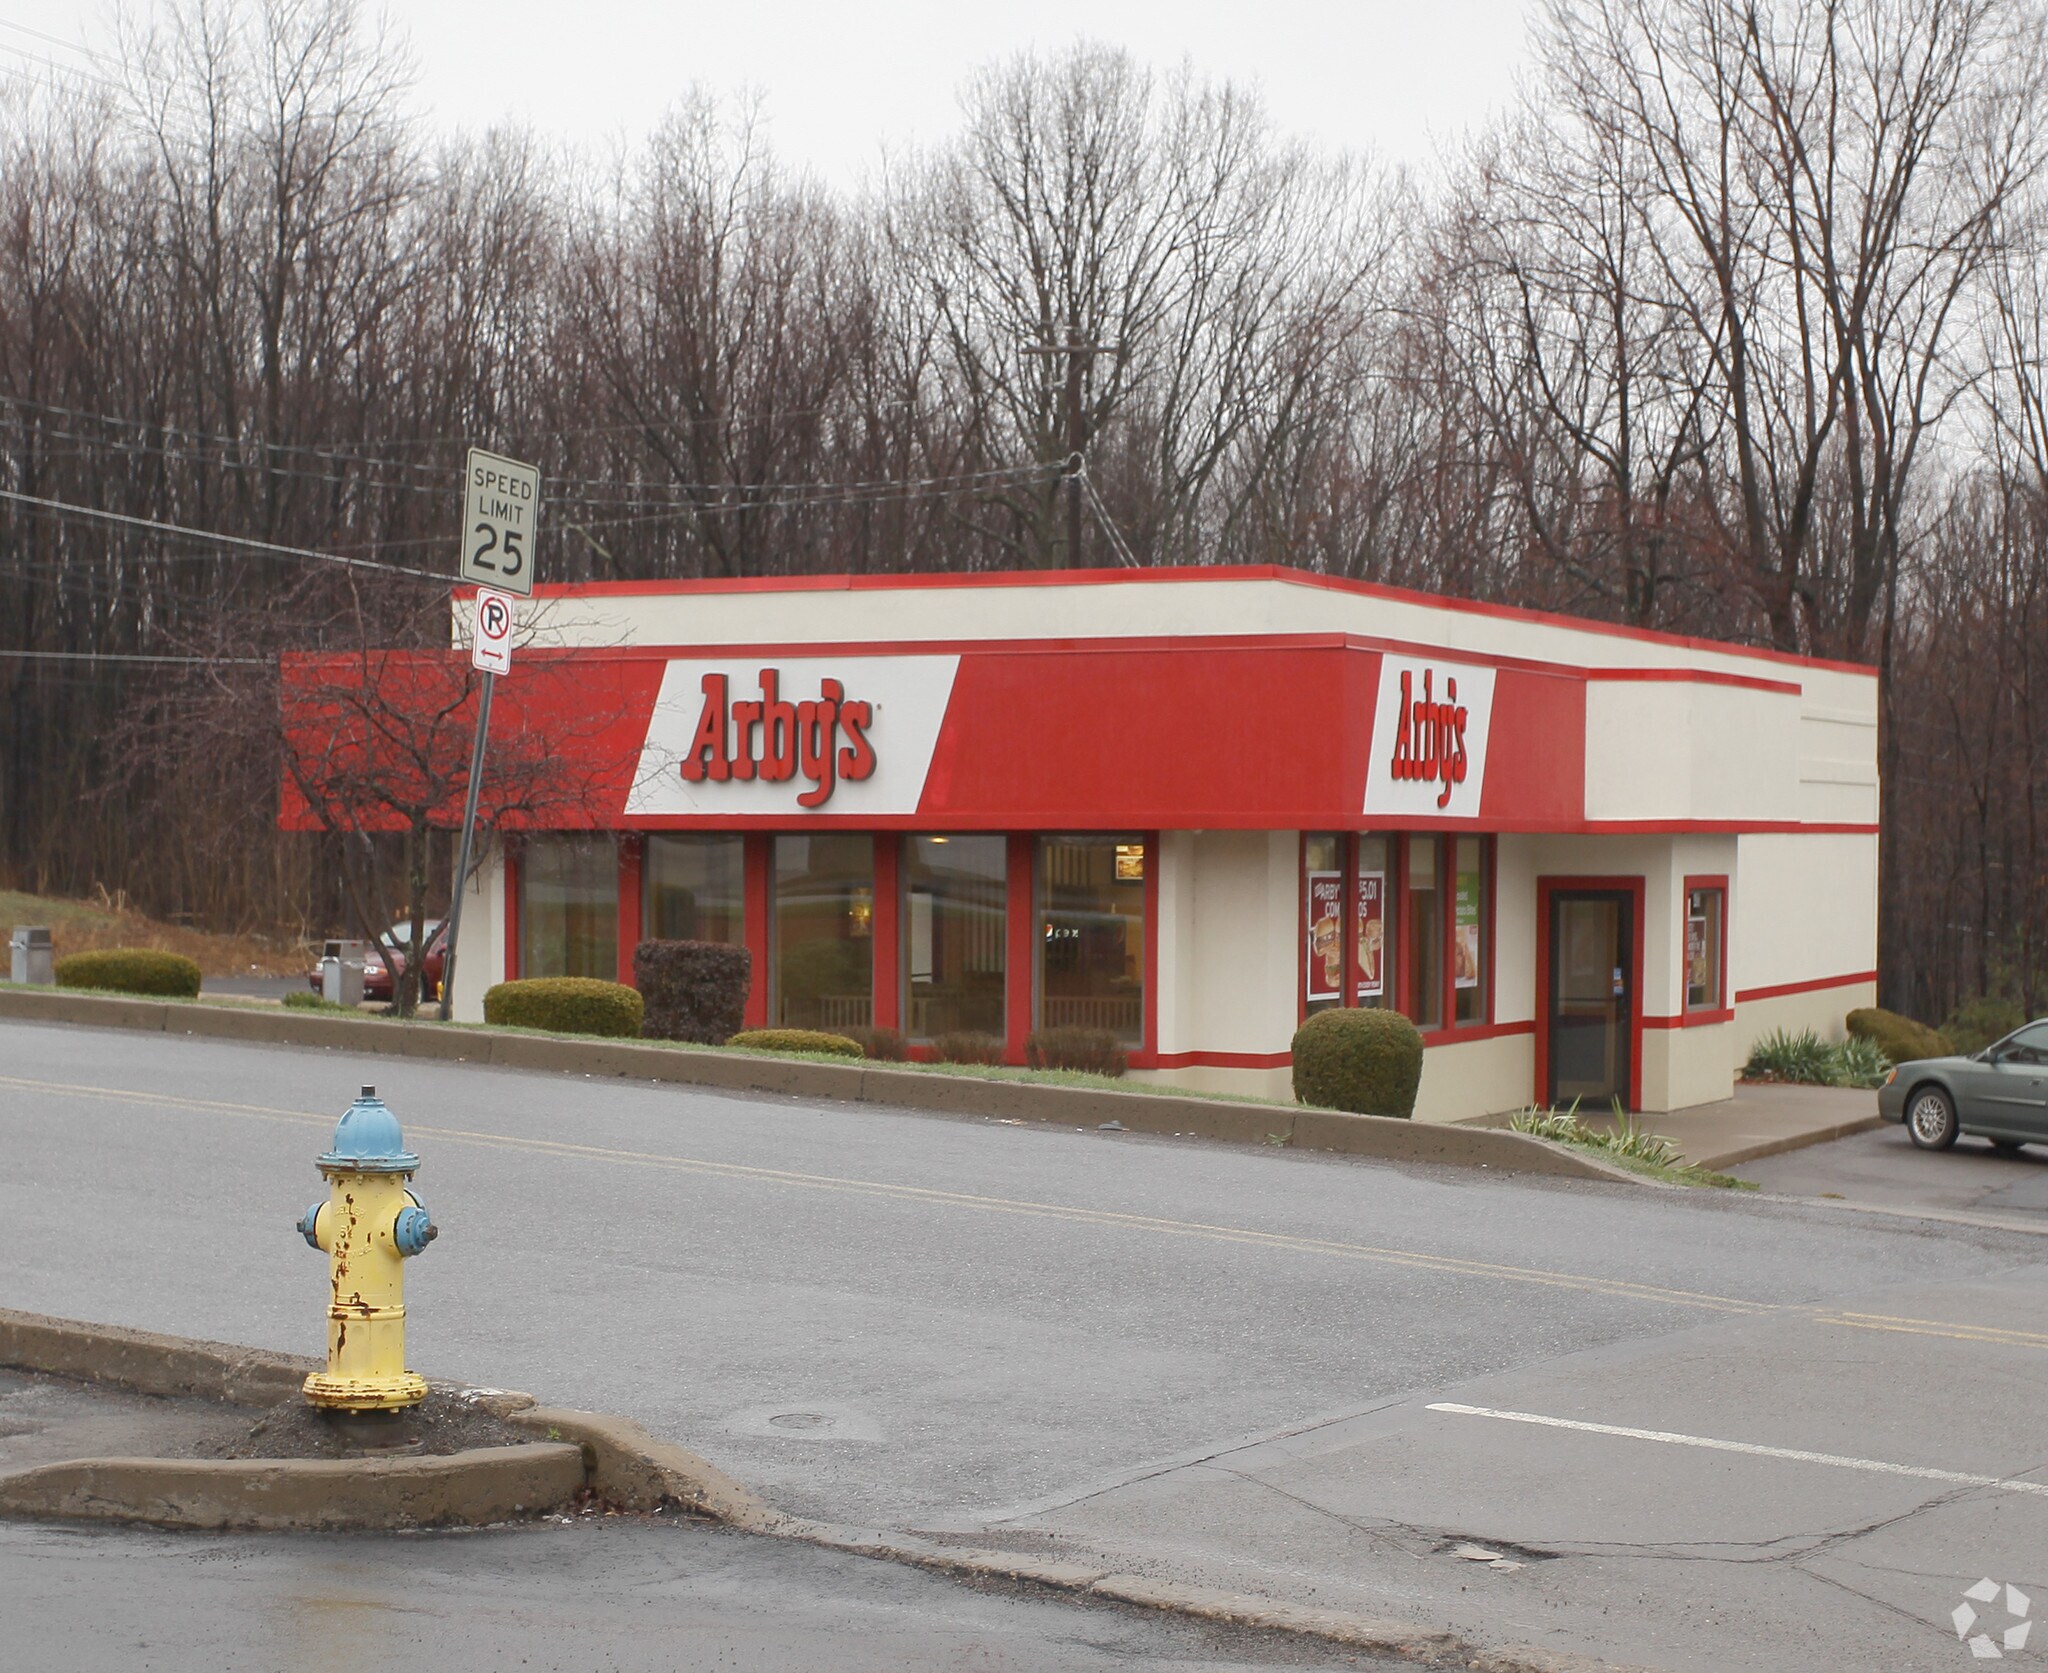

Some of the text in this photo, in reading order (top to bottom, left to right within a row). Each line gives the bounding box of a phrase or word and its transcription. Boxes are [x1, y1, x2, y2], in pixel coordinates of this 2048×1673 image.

[474, 468, 532, 500] SPEED
[479, 496, 523, 524] LIMIT
[473, 523, 523, 576] 25
[680, 668, 878, 808] Arby's
[1391, 668, 1468, 809] Arby's
